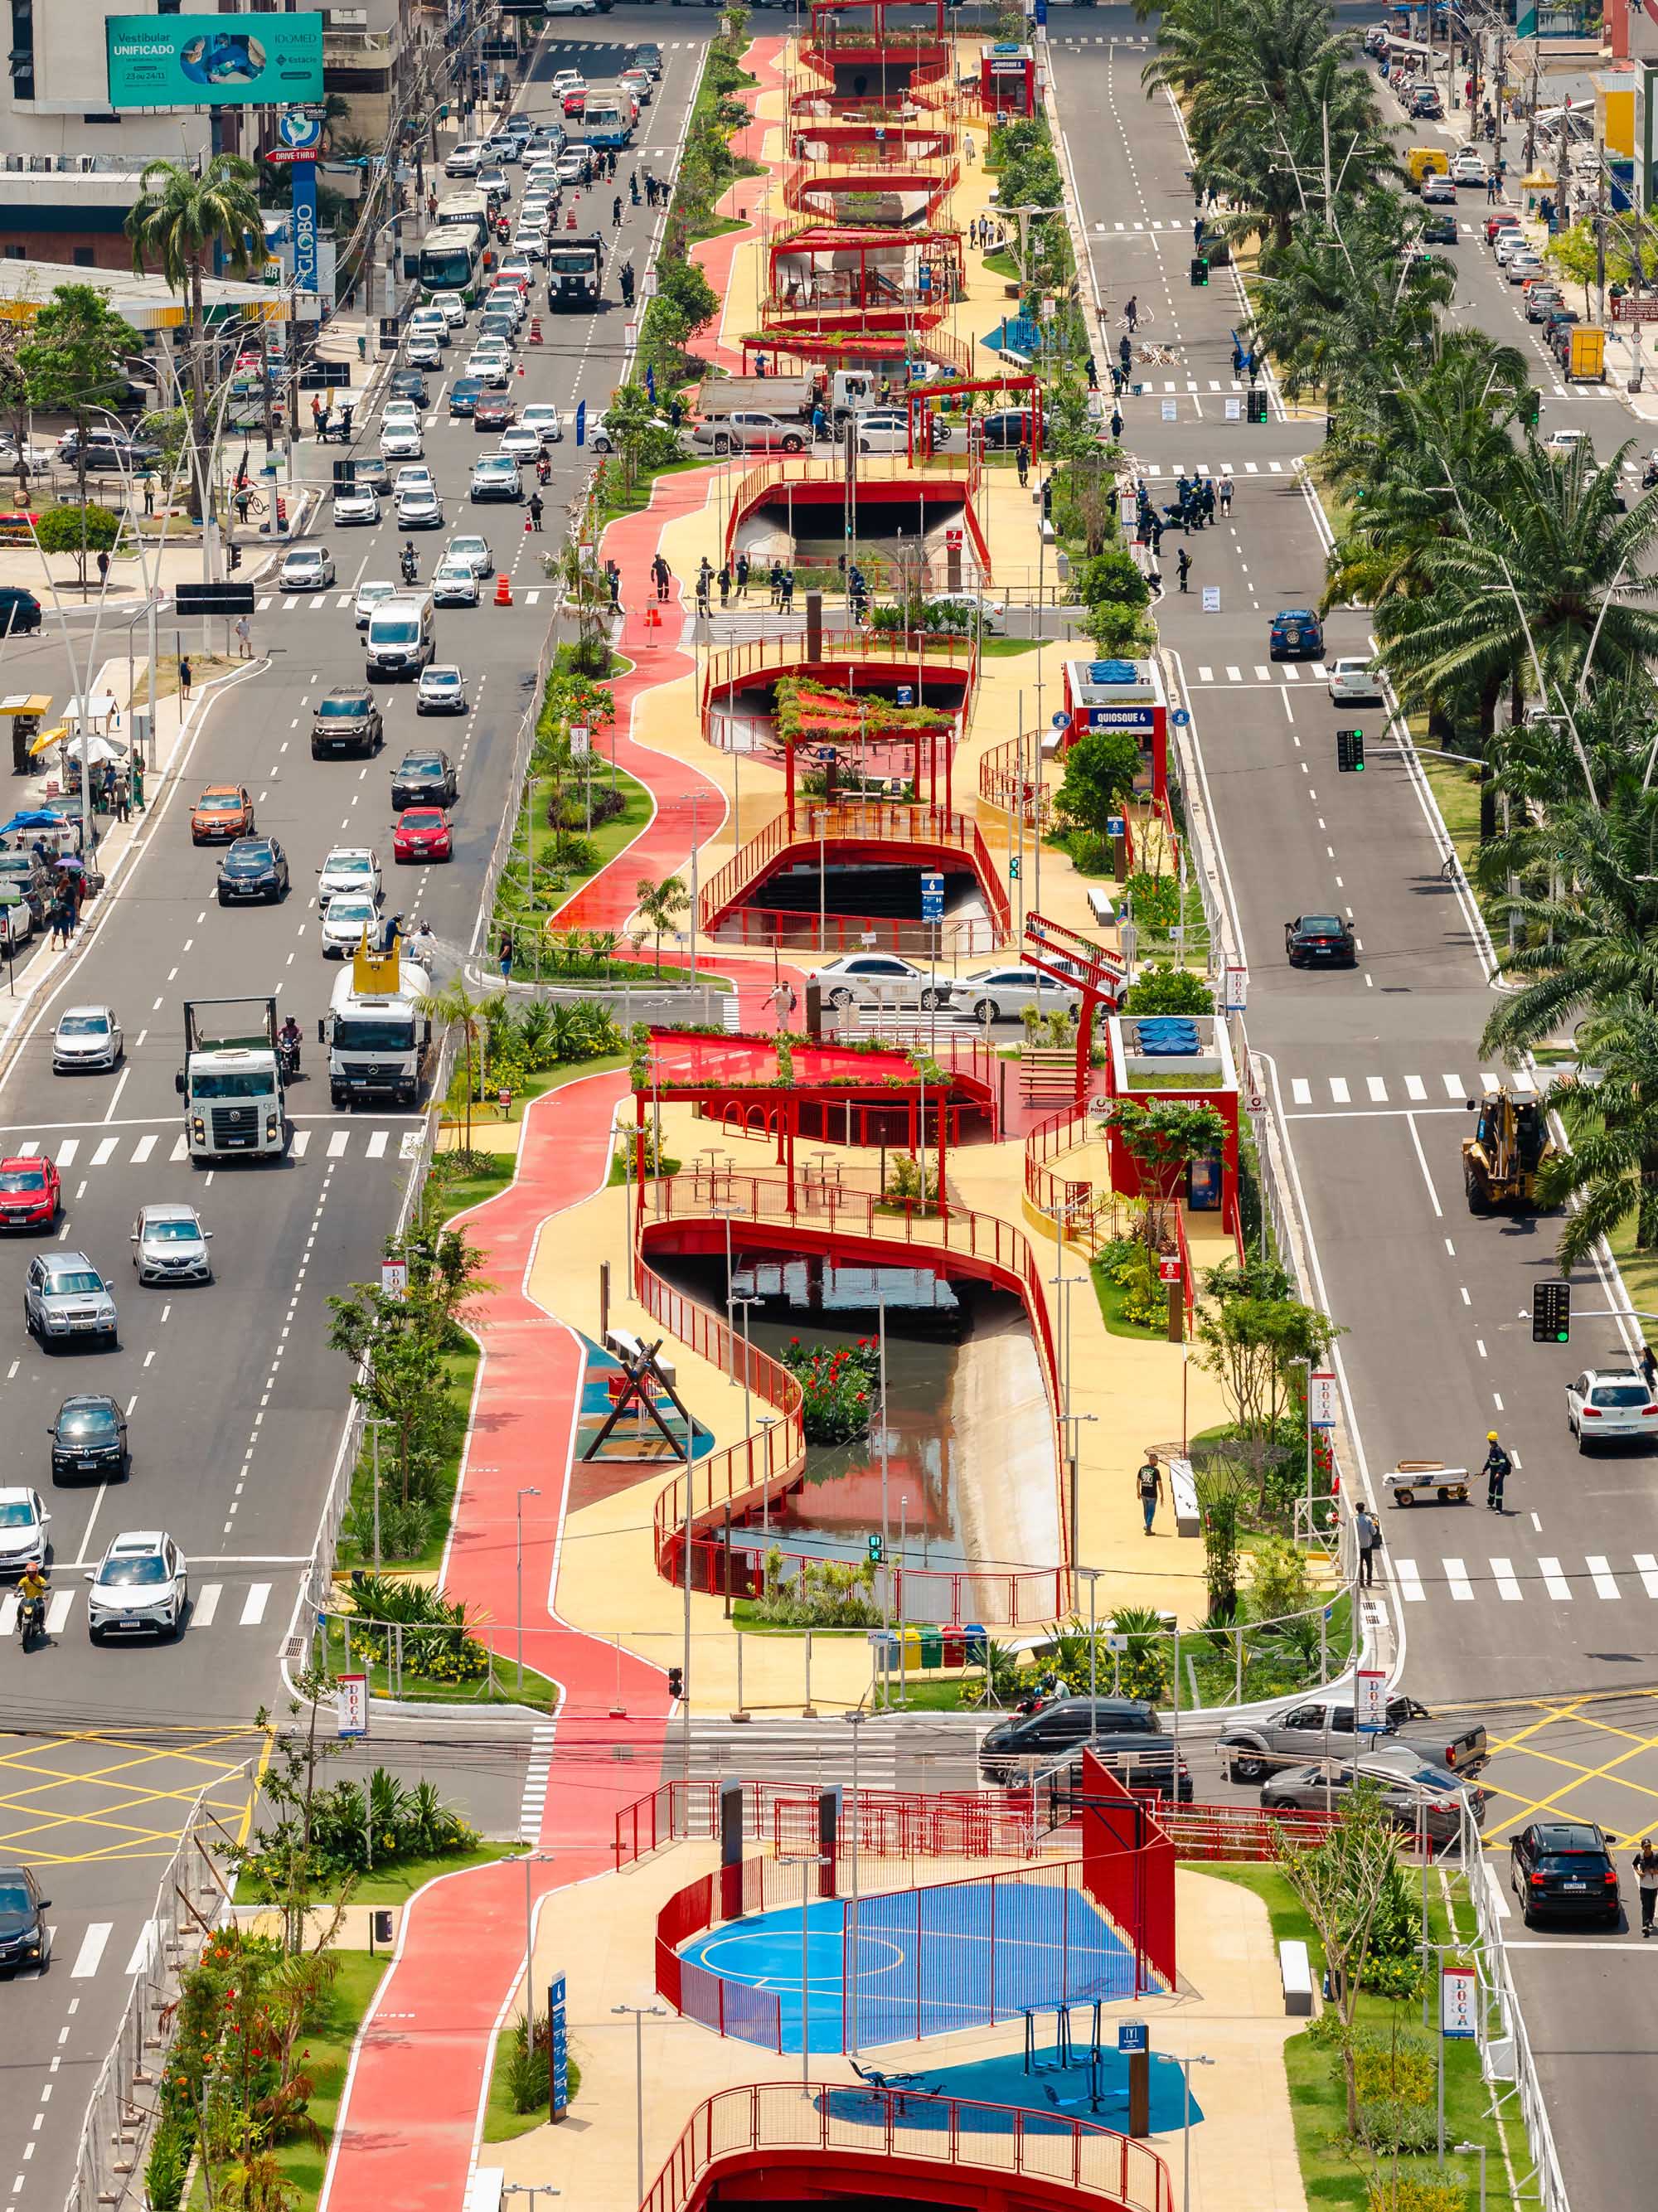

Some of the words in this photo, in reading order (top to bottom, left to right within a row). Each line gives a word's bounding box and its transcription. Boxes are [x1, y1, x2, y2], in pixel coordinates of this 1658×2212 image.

[119, 33, 171, 42] Vestibular
[114, 45, 175, 56] UNIFICADO
[126, 72, 135, 80] 23
[146, 72, 165, 80] 24/11
[276, 149, 315, 160] DRIVE-THRU
[297, 204, 314, 275] GLOBO
[264, 266, 279, 279] BR
[952, 531, 957, 539] 7
[1098, 713, 1138, 723] QUIOSQUE
[1140, 713, 1146, 722] 4
[929, 880, 935, 890] 6
[1321, 1382, 1331, 1418] DOCA
[348, 1684, 358, 1725] DOCA
[1370, 1681, 1379, 1721] DOCA
[556, 1984, 562, 2000] 4
[1456, 1978, 1468, 2025] DOCA
